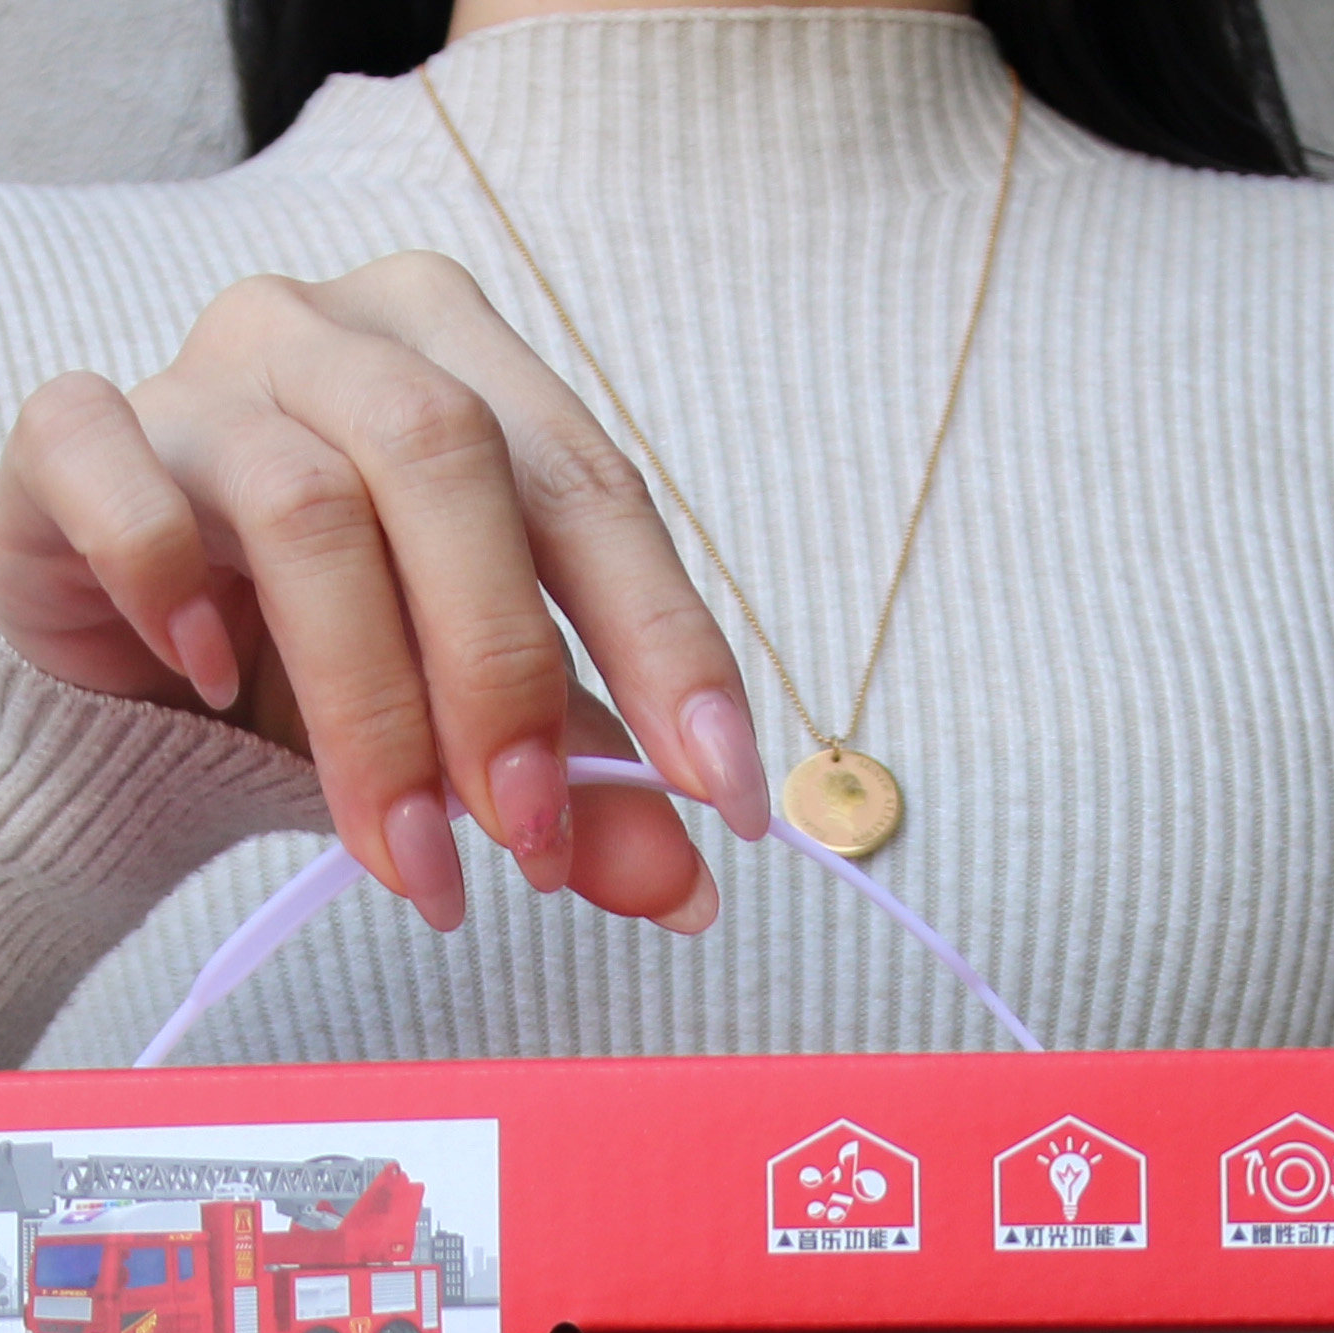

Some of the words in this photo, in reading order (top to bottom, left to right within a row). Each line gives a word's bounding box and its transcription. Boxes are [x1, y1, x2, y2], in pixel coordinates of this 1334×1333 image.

[798, 1229, 888, 1250] 音乐功能
[1025, 1225, 1115, 1247] 灯光功能
